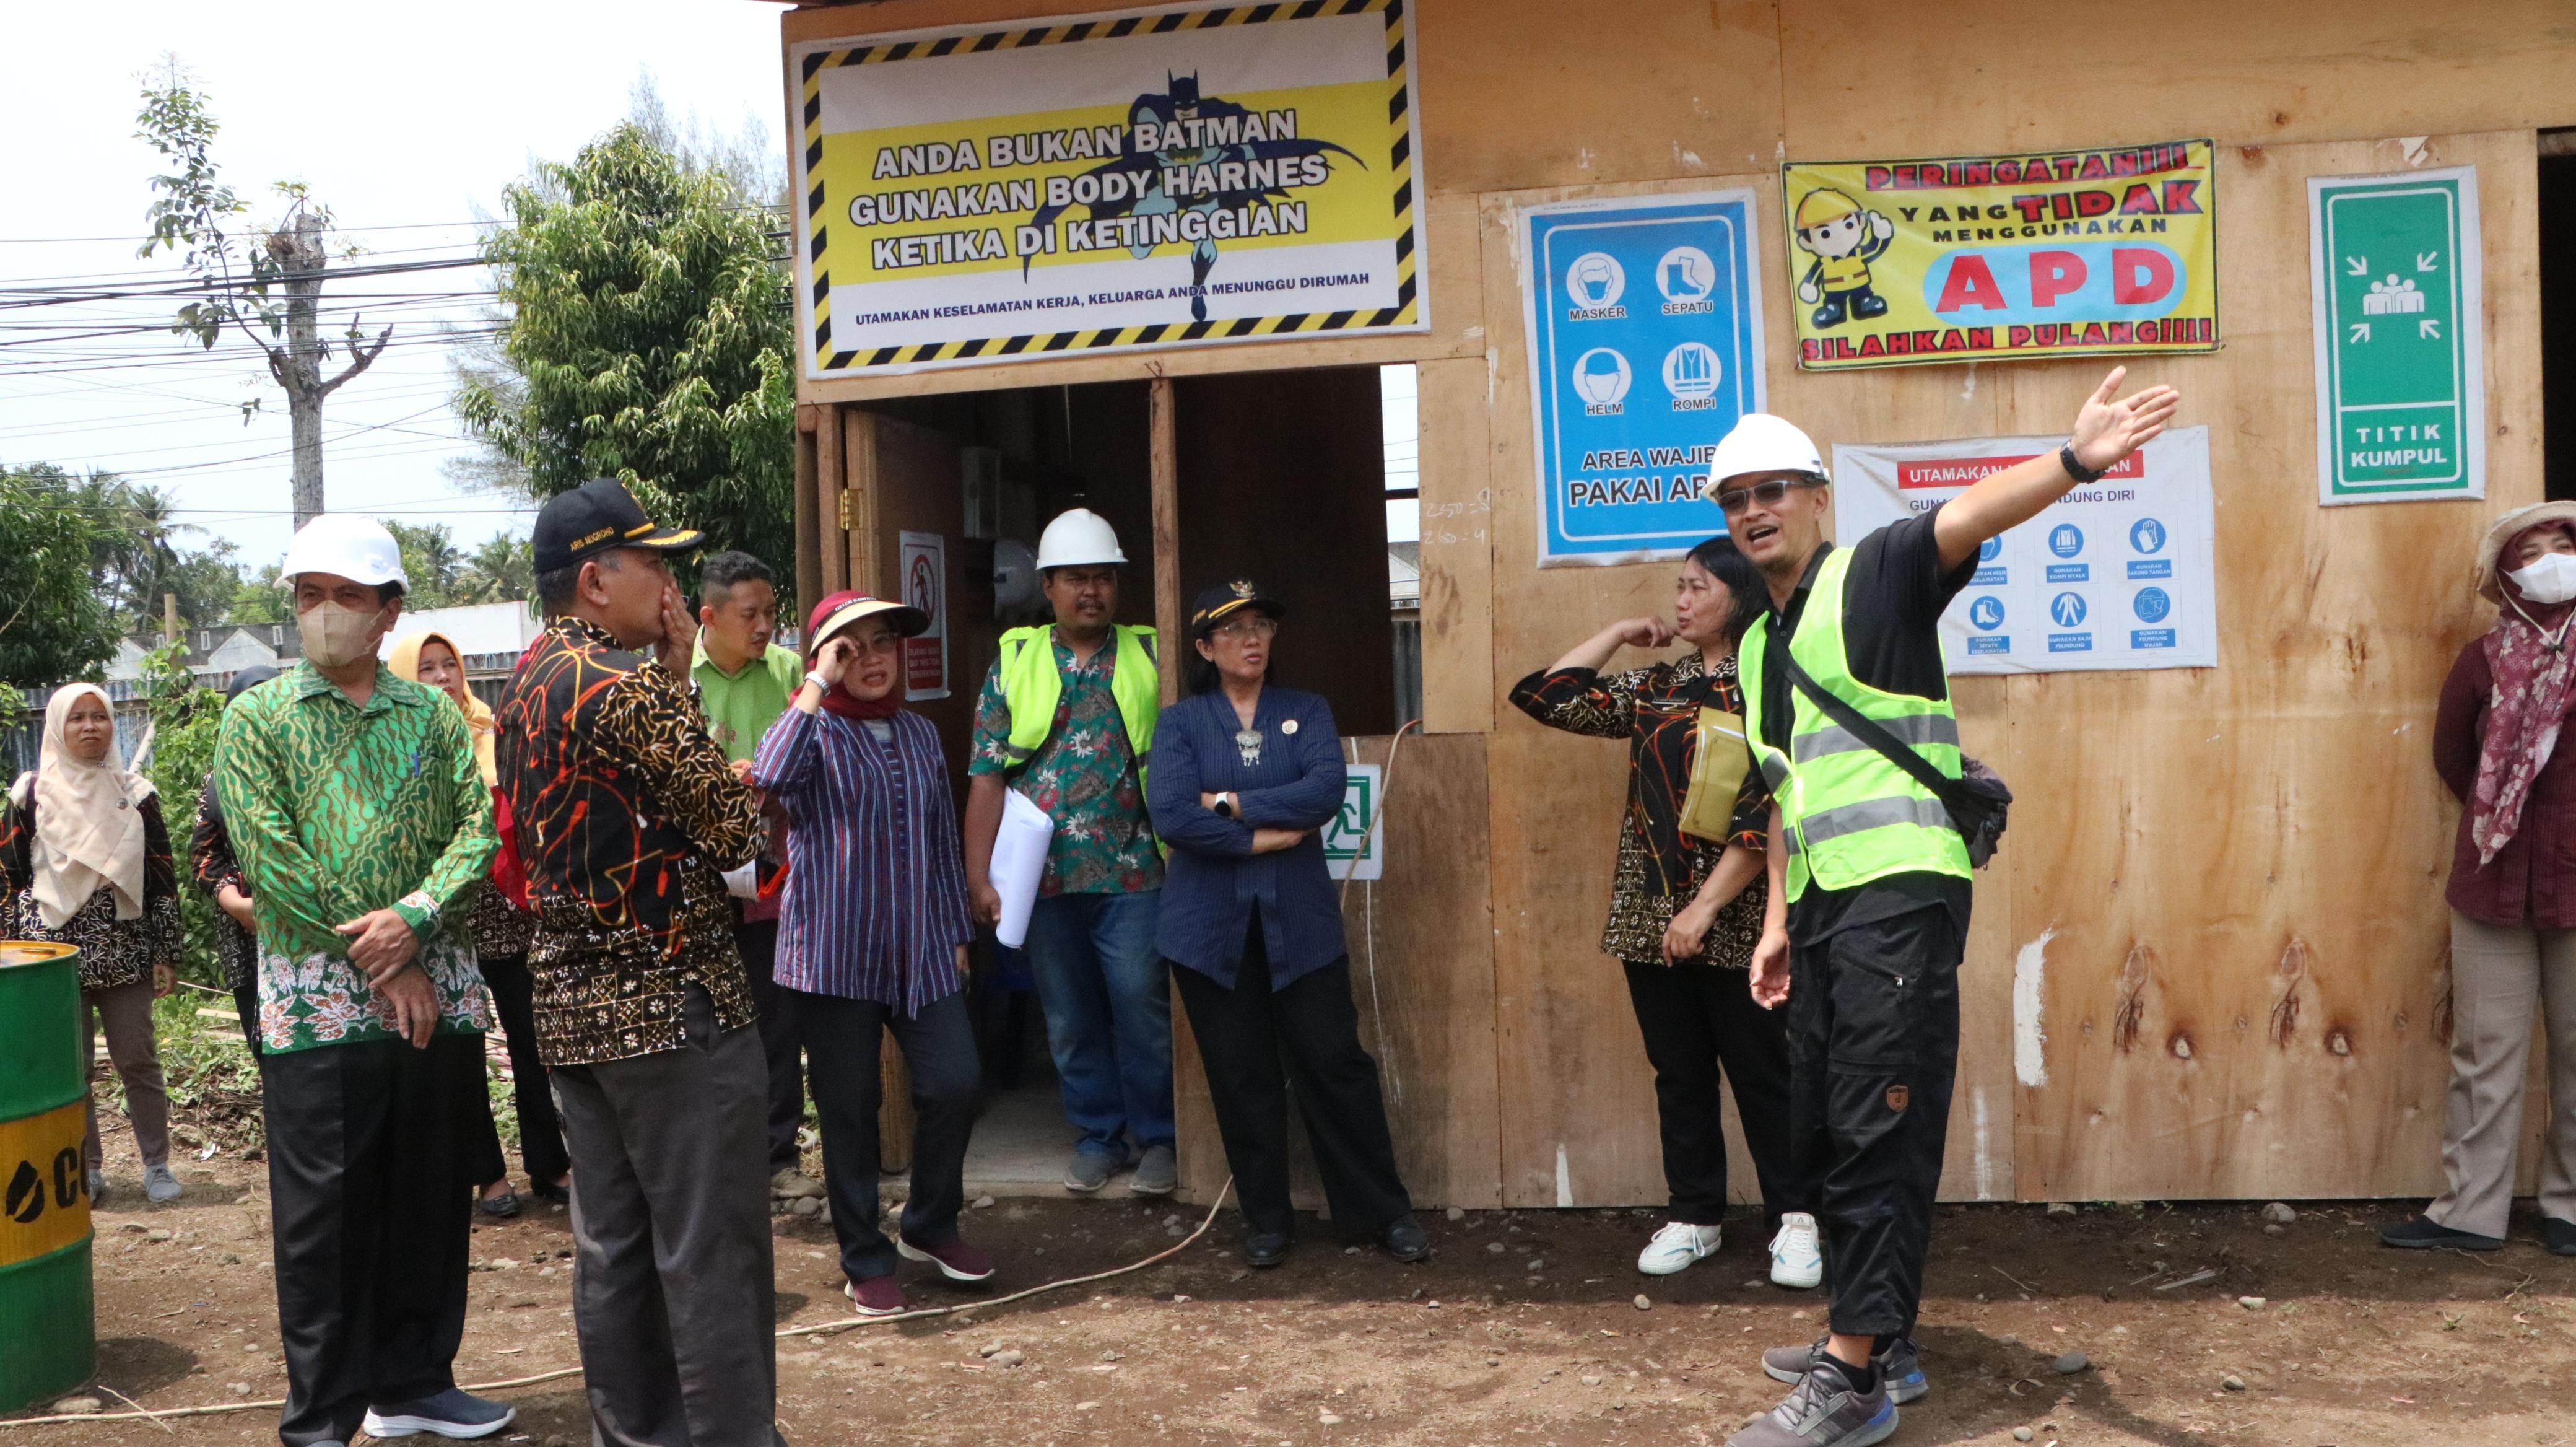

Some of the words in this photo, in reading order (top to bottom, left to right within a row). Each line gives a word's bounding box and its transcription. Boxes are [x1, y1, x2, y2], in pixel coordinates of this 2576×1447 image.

[873, 142, 980, 181] ANDA
[989, 125, 1123, 168] BUKAN
[1134, 109, 1297, 154] BATMAN
[1865, 144, 2188, 191] PERINGATAN!!!
[850, 178, 1036, 228] GUNAKAN
[1047, 168, 1154, 209] BODY
[1163, 154, 1328, 198] HARNES
[1899, 204, 2008, 223] YANG
[2012, 180, 2203, 223] TIDAK
[872, 228, 1007, 270] KETIKA
[1016, 224, 1056, 256] DI
[1068, 202, 1307, 252] KETINGGIAN
[1933, 219, 2167, 242] MENGGUNAKAN
[1935, 248, 2175, 313] APD
[855, 311, 930, 326] UTAMAKAN
[934, 300, 1032, 319] KESELAMATAN
[1037, 294, 1084, 311] KERJA,
[1089, 288, 1165, 308] KELUARGA
[1168, 285, 1208, 301] ANDA
[1211, 278, 1295, 297] MENUNGGU
[1300, 273, 1369, 289] DIRUMAH
[1663, 302, 1713, 314] SEPATU
[1570, 308, 1625, 320] MASKER
[1802, 328, 1995, 360] SILAHKAN
[1586, 403, 1623, 415] HELM
[1673, 398, 1716, 410] ROMPI
[2356, 425, 2440, 444] TITIK
[1582, 450, 1643, 471] AREA
[1649, 445, 1717, 467] WAJIB
[2351, 448, 2447, 467] KUMPUL
[1570, 477, 1661, 507] PAKAI
[1668, 475, 1709, 502] AP
[2108, 490, 2134, 501] DIRI
[570, 538, 585, 552] ARIS
[584, 527, 614, 545] NUGROHO
